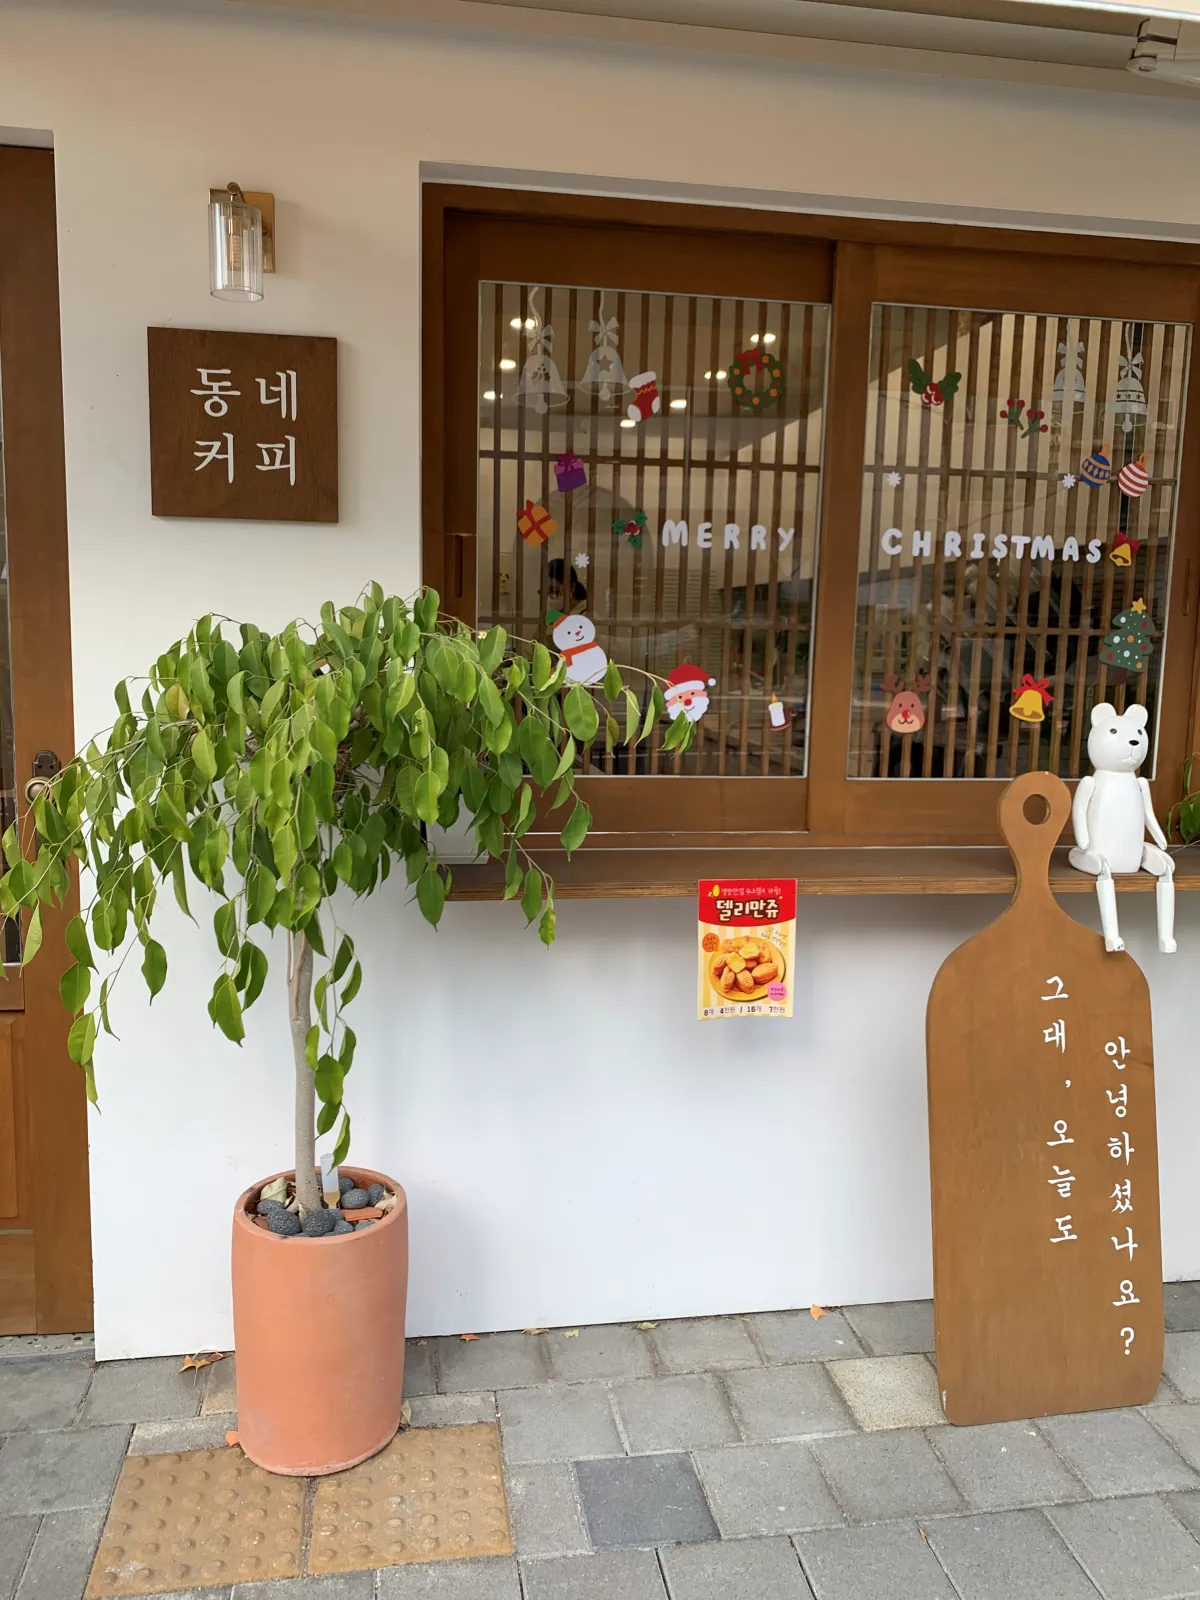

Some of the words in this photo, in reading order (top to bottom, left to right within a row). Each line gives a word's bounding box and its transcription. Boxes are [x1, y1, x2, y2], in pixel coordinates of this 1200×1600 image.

[191, 368, 297, 421] 동네
[193, 432, 296, 486] 커피
[661, 519, 795, 551] MERRY
[881, 528, 1102, 563] CHRISTMAS
[716, 899, 779, 922] 델리만쥬
[720, 1006, 736, 1014] 4천원
[1041, 975, 1071, 1088] 그대,
[1046, 1119, 1078, 1243] 오늘도
[1104, 1036, 1140, 1355] 안녕하셨나요?
